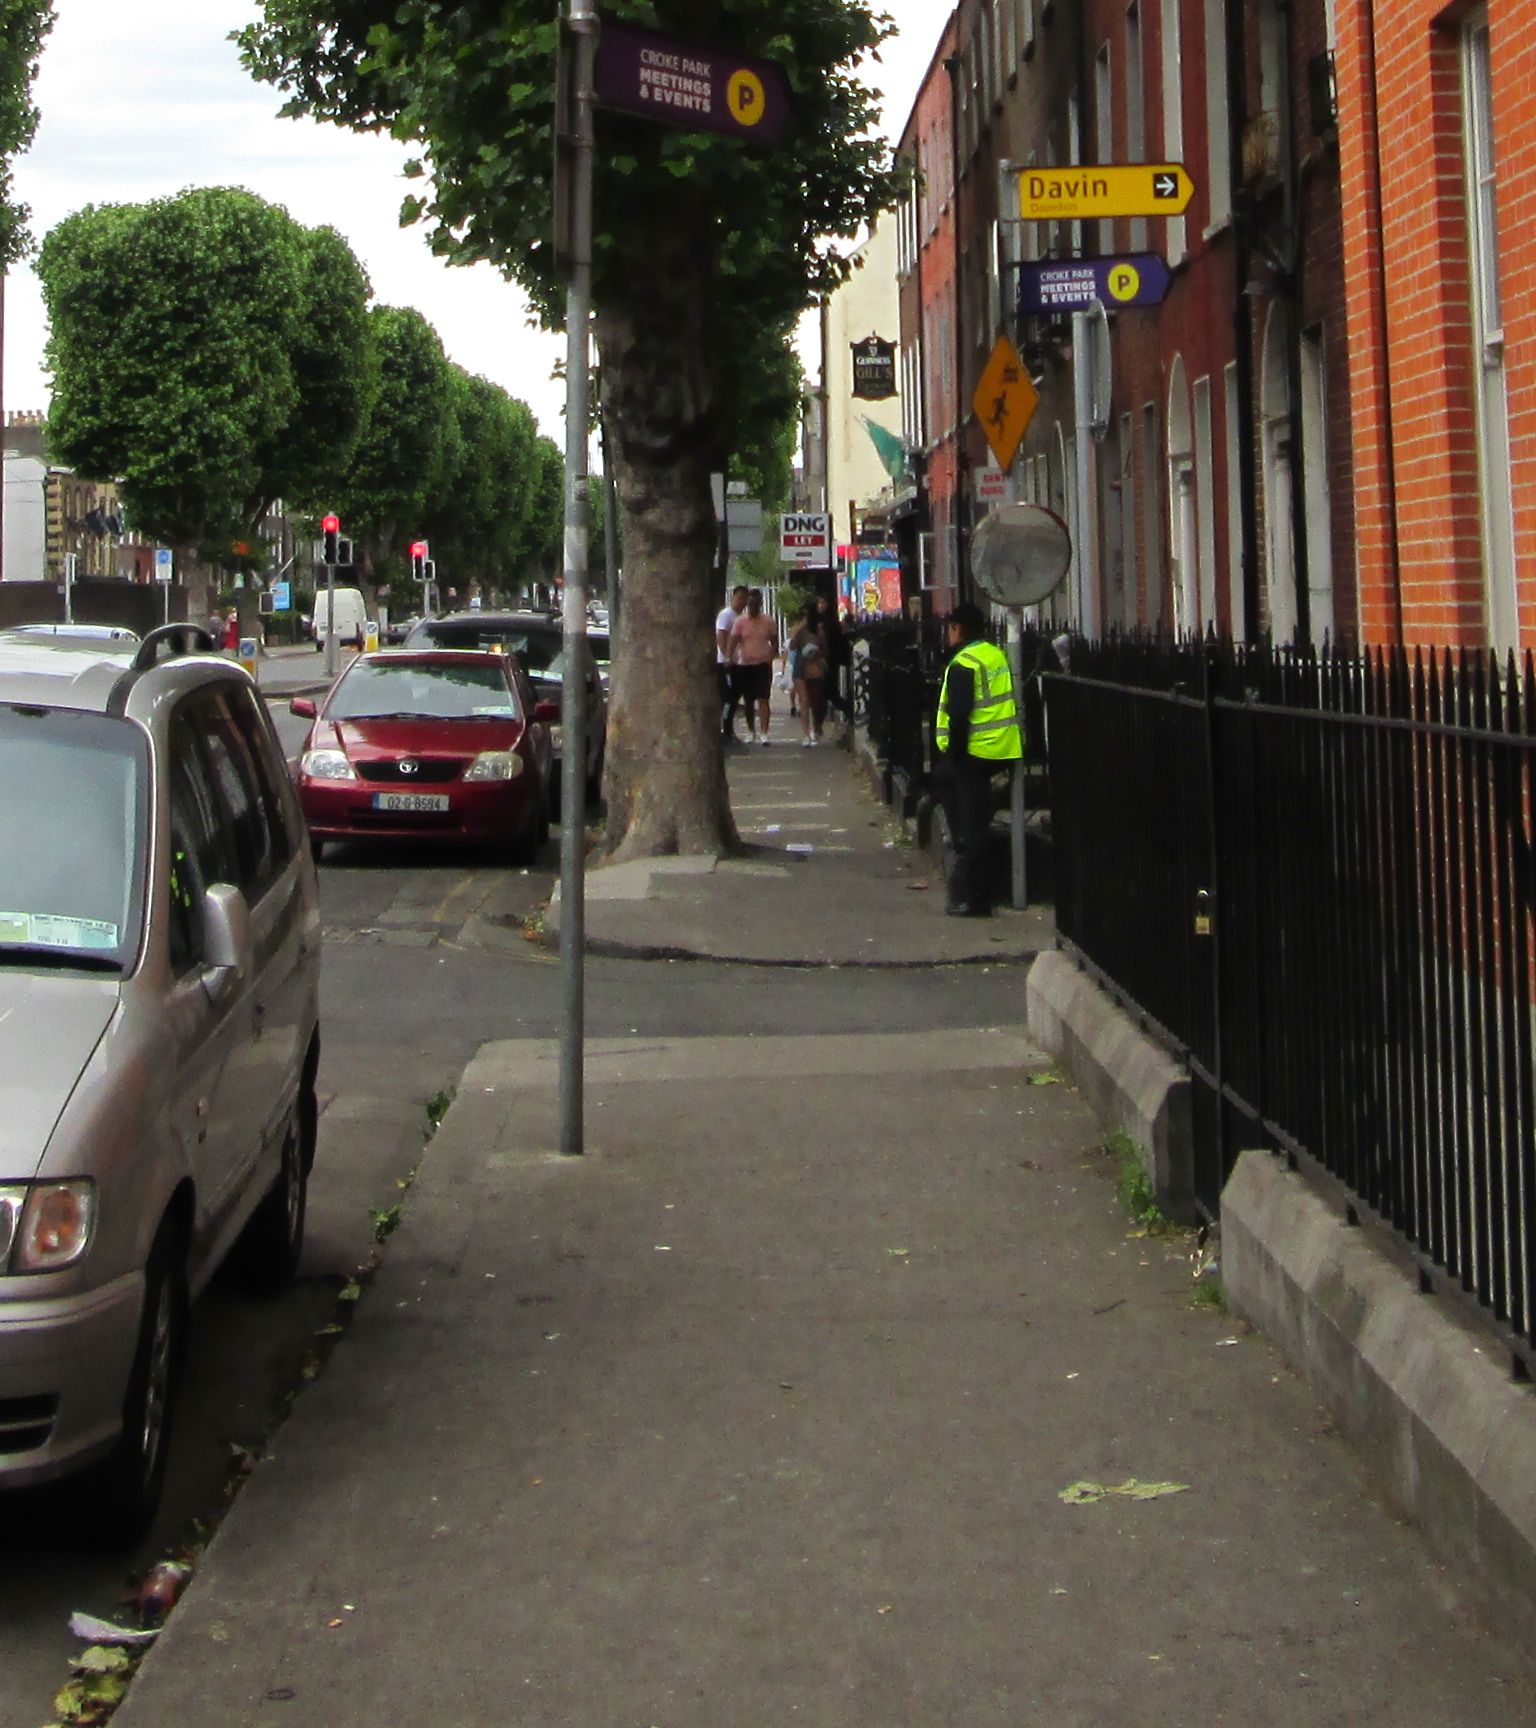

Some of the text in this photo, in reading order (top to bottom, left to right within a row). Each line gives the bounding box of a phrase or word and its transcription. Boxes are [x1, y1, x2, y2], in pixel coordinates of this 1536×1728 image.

[640, 49, 712, 78] CROKE PARK
[639, 67, 712, 97] MEETINGS
[640, 84, 712, 113] & EVENTS
[1029, 173, 1108, 200] Davin
[1072, 269, 1095, 280] PARK
[1040, 281, 1096, 294] MEETINGS
[1052, 291, 1097, 304] EVENTS
[784, 516, 825, 532] DNG
